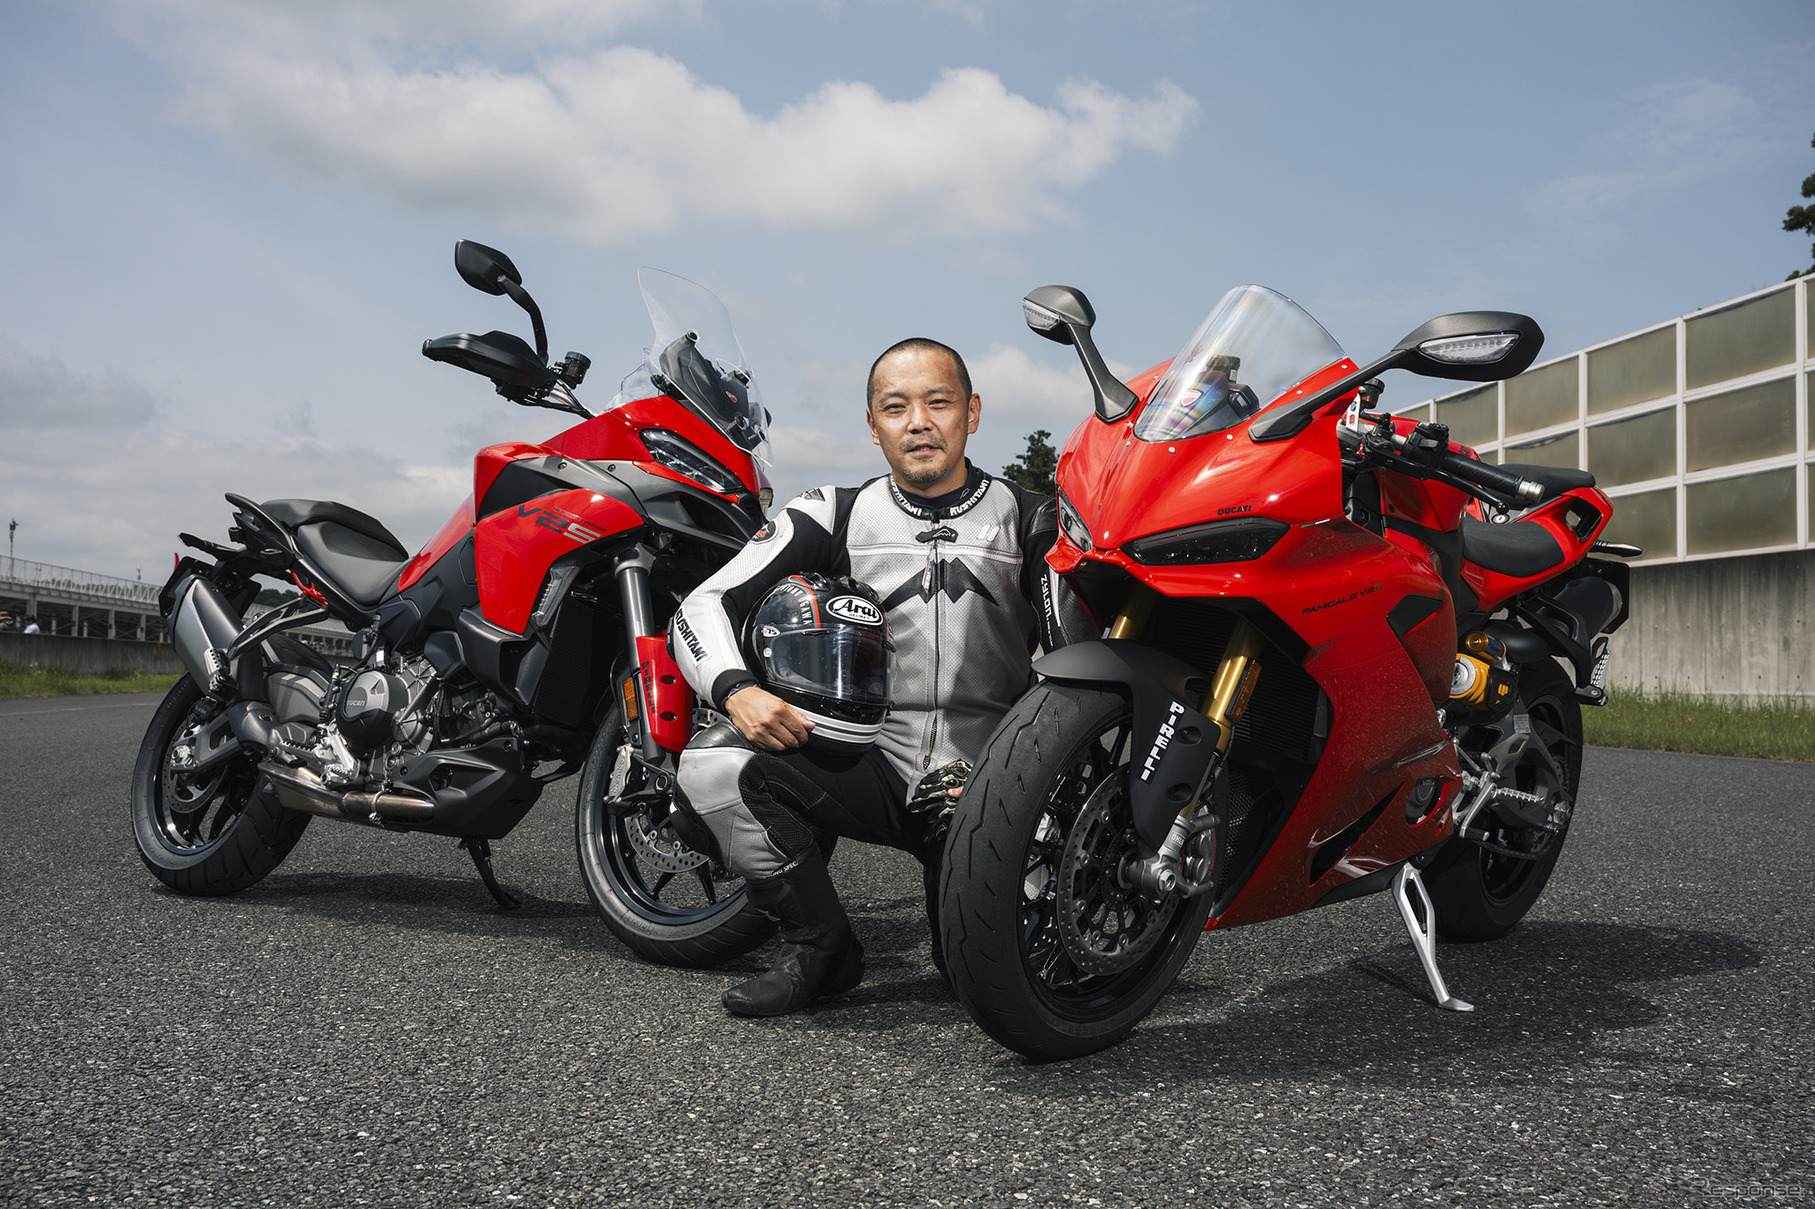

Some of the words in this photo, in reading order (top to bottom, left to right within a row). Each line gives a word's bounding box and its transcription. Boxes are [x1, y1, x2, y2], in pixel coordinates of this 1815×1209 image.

[1217, 505, 1252, 516] DUCATI
[832, 599, 878, 619] Arai
[1301, 592, 1359, 615] PANIGALE
[1359, 583, 1382, 597] V2S
[641, 661, 656, 714] PIRELLI
[1140, 701, 1185, 781] PIRELLI
